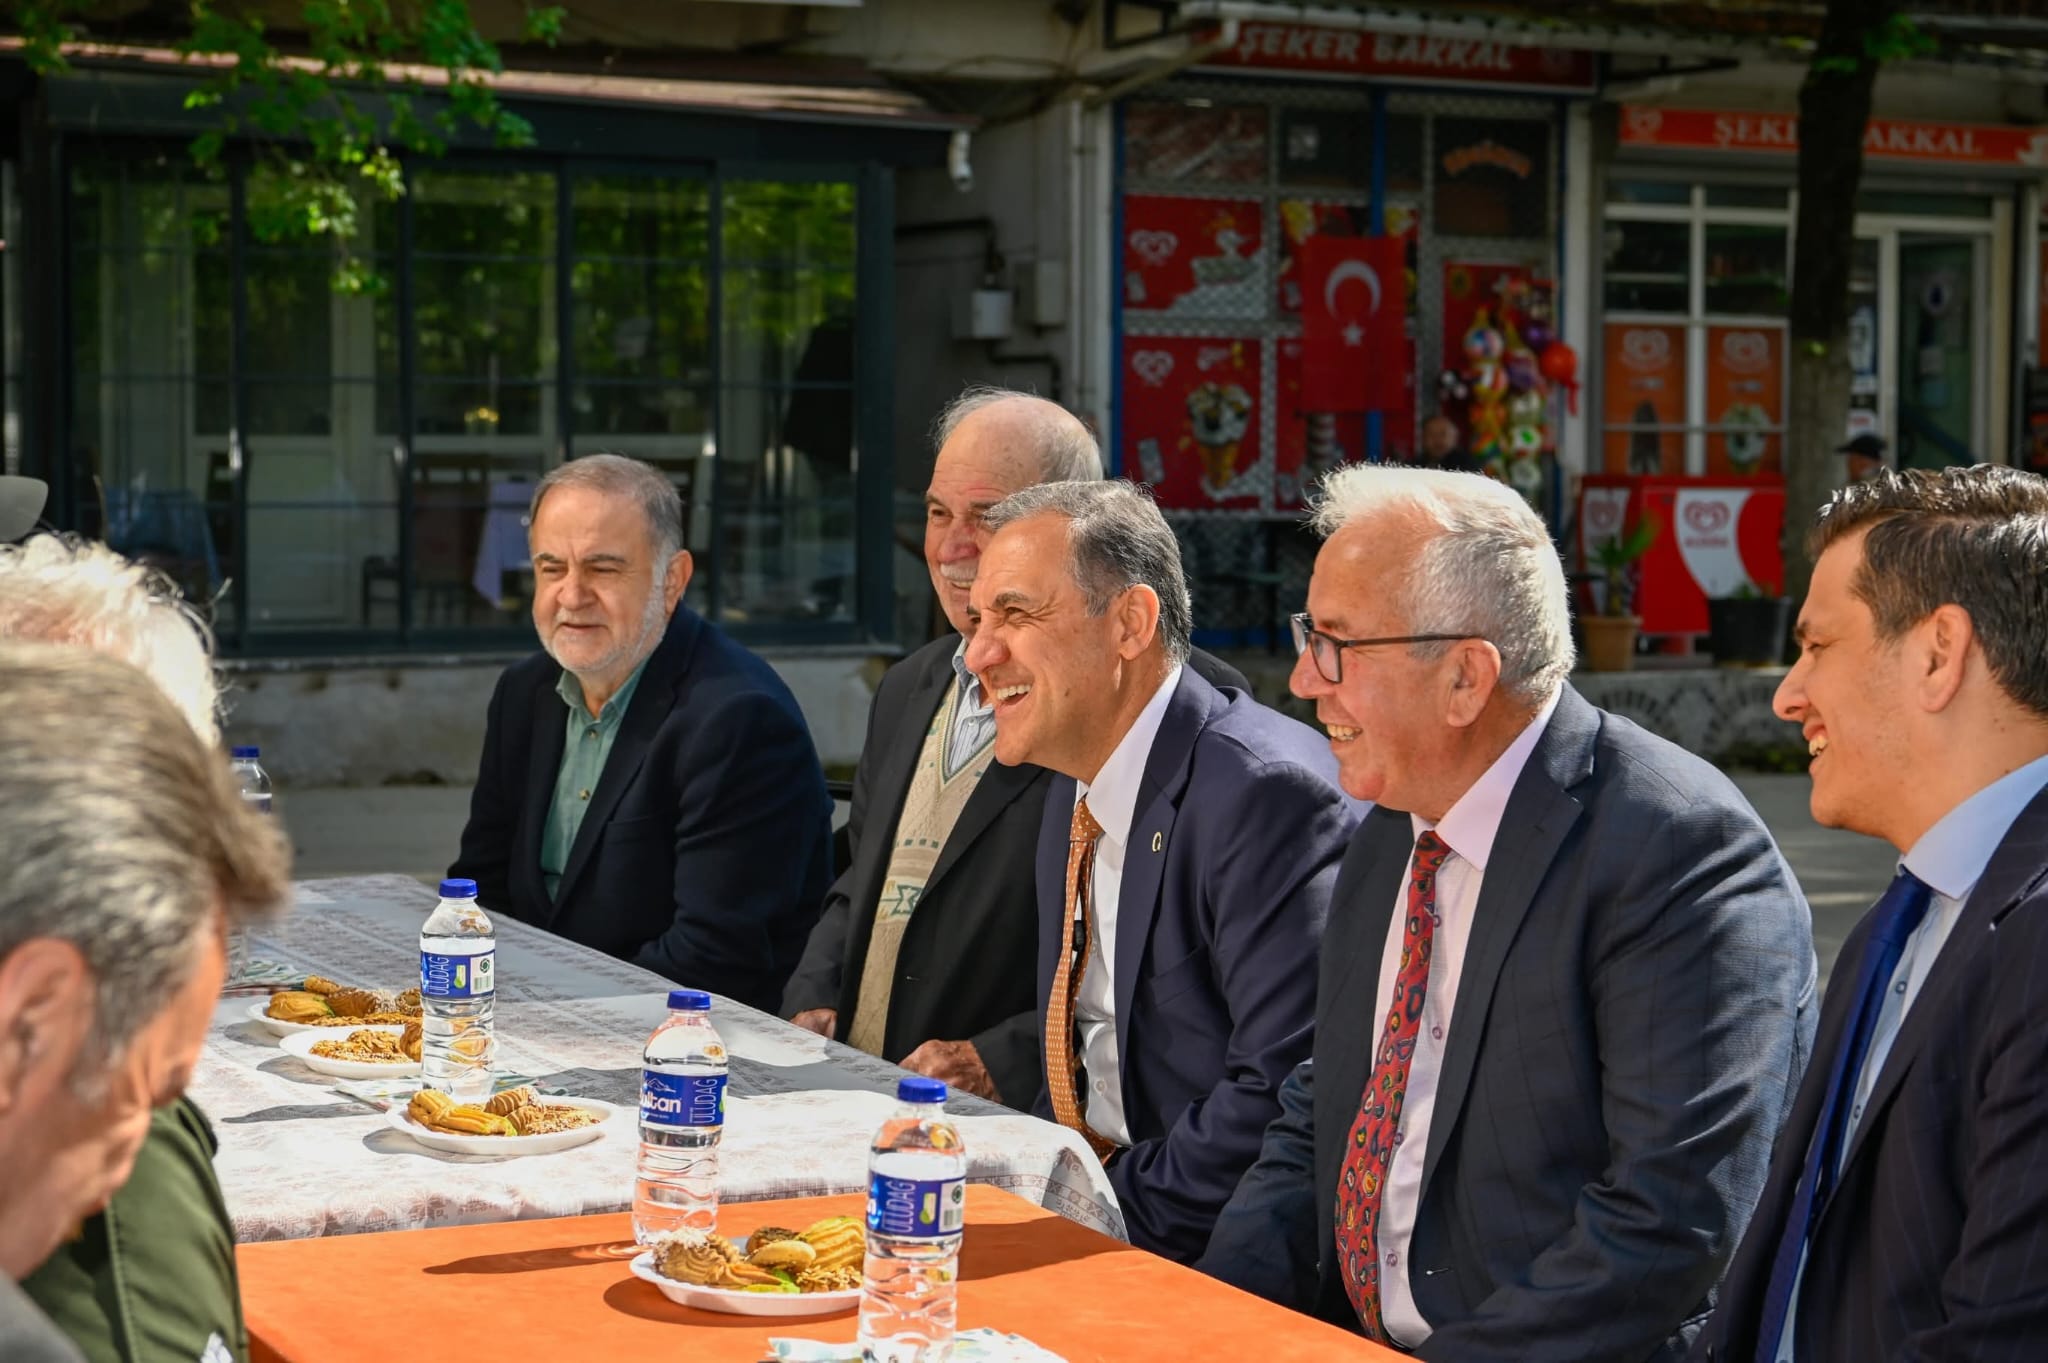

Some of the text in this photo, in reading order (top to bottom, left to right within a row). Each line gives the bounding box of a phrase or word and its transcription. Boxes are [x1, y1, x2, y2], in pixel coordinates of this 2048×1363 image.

[1239, 26, 1514, 70] ŞEKER BAKKAL
[1862, 124, 1981, 155] AKKAL
[428, 956, 450, 995] ULUDAĞ
[640, 1091, 681, 1113] ultan
[693, 1079, 718, 1123] ULUDAĞ
